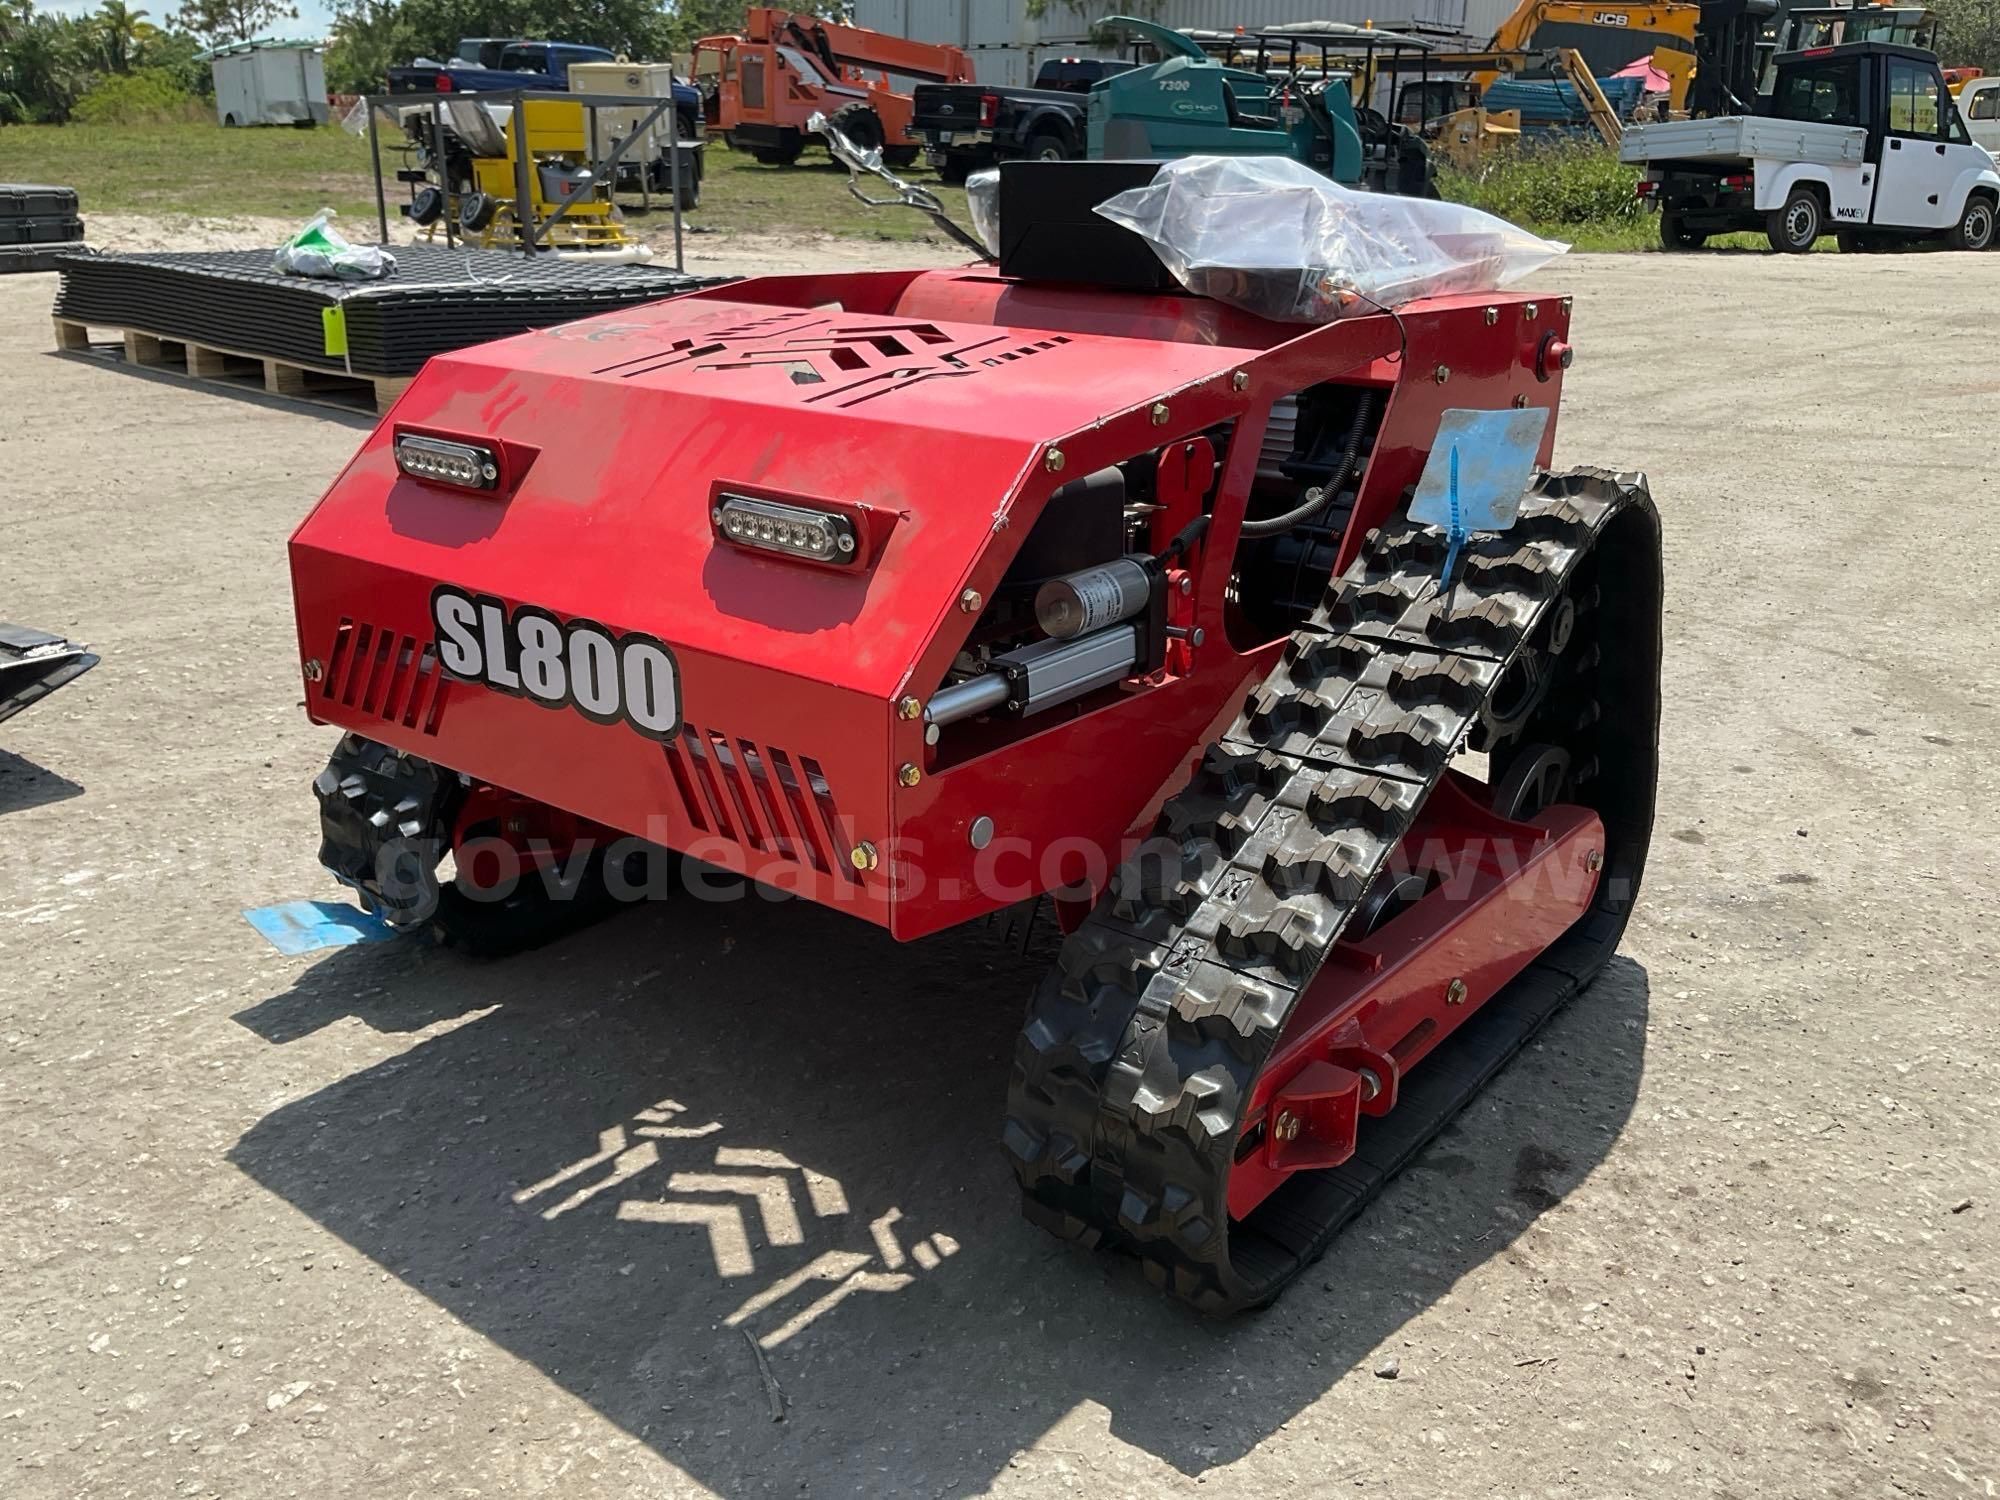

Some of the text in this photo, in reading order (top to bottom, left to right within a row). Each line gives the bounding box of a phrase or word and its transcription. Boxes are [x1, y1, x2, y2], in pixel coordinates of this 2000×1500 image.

[1593, 13, 1628, 26] JCB
[1159, 81, 1190, 91] 7300
[436, 593, 677, 733] SL800
